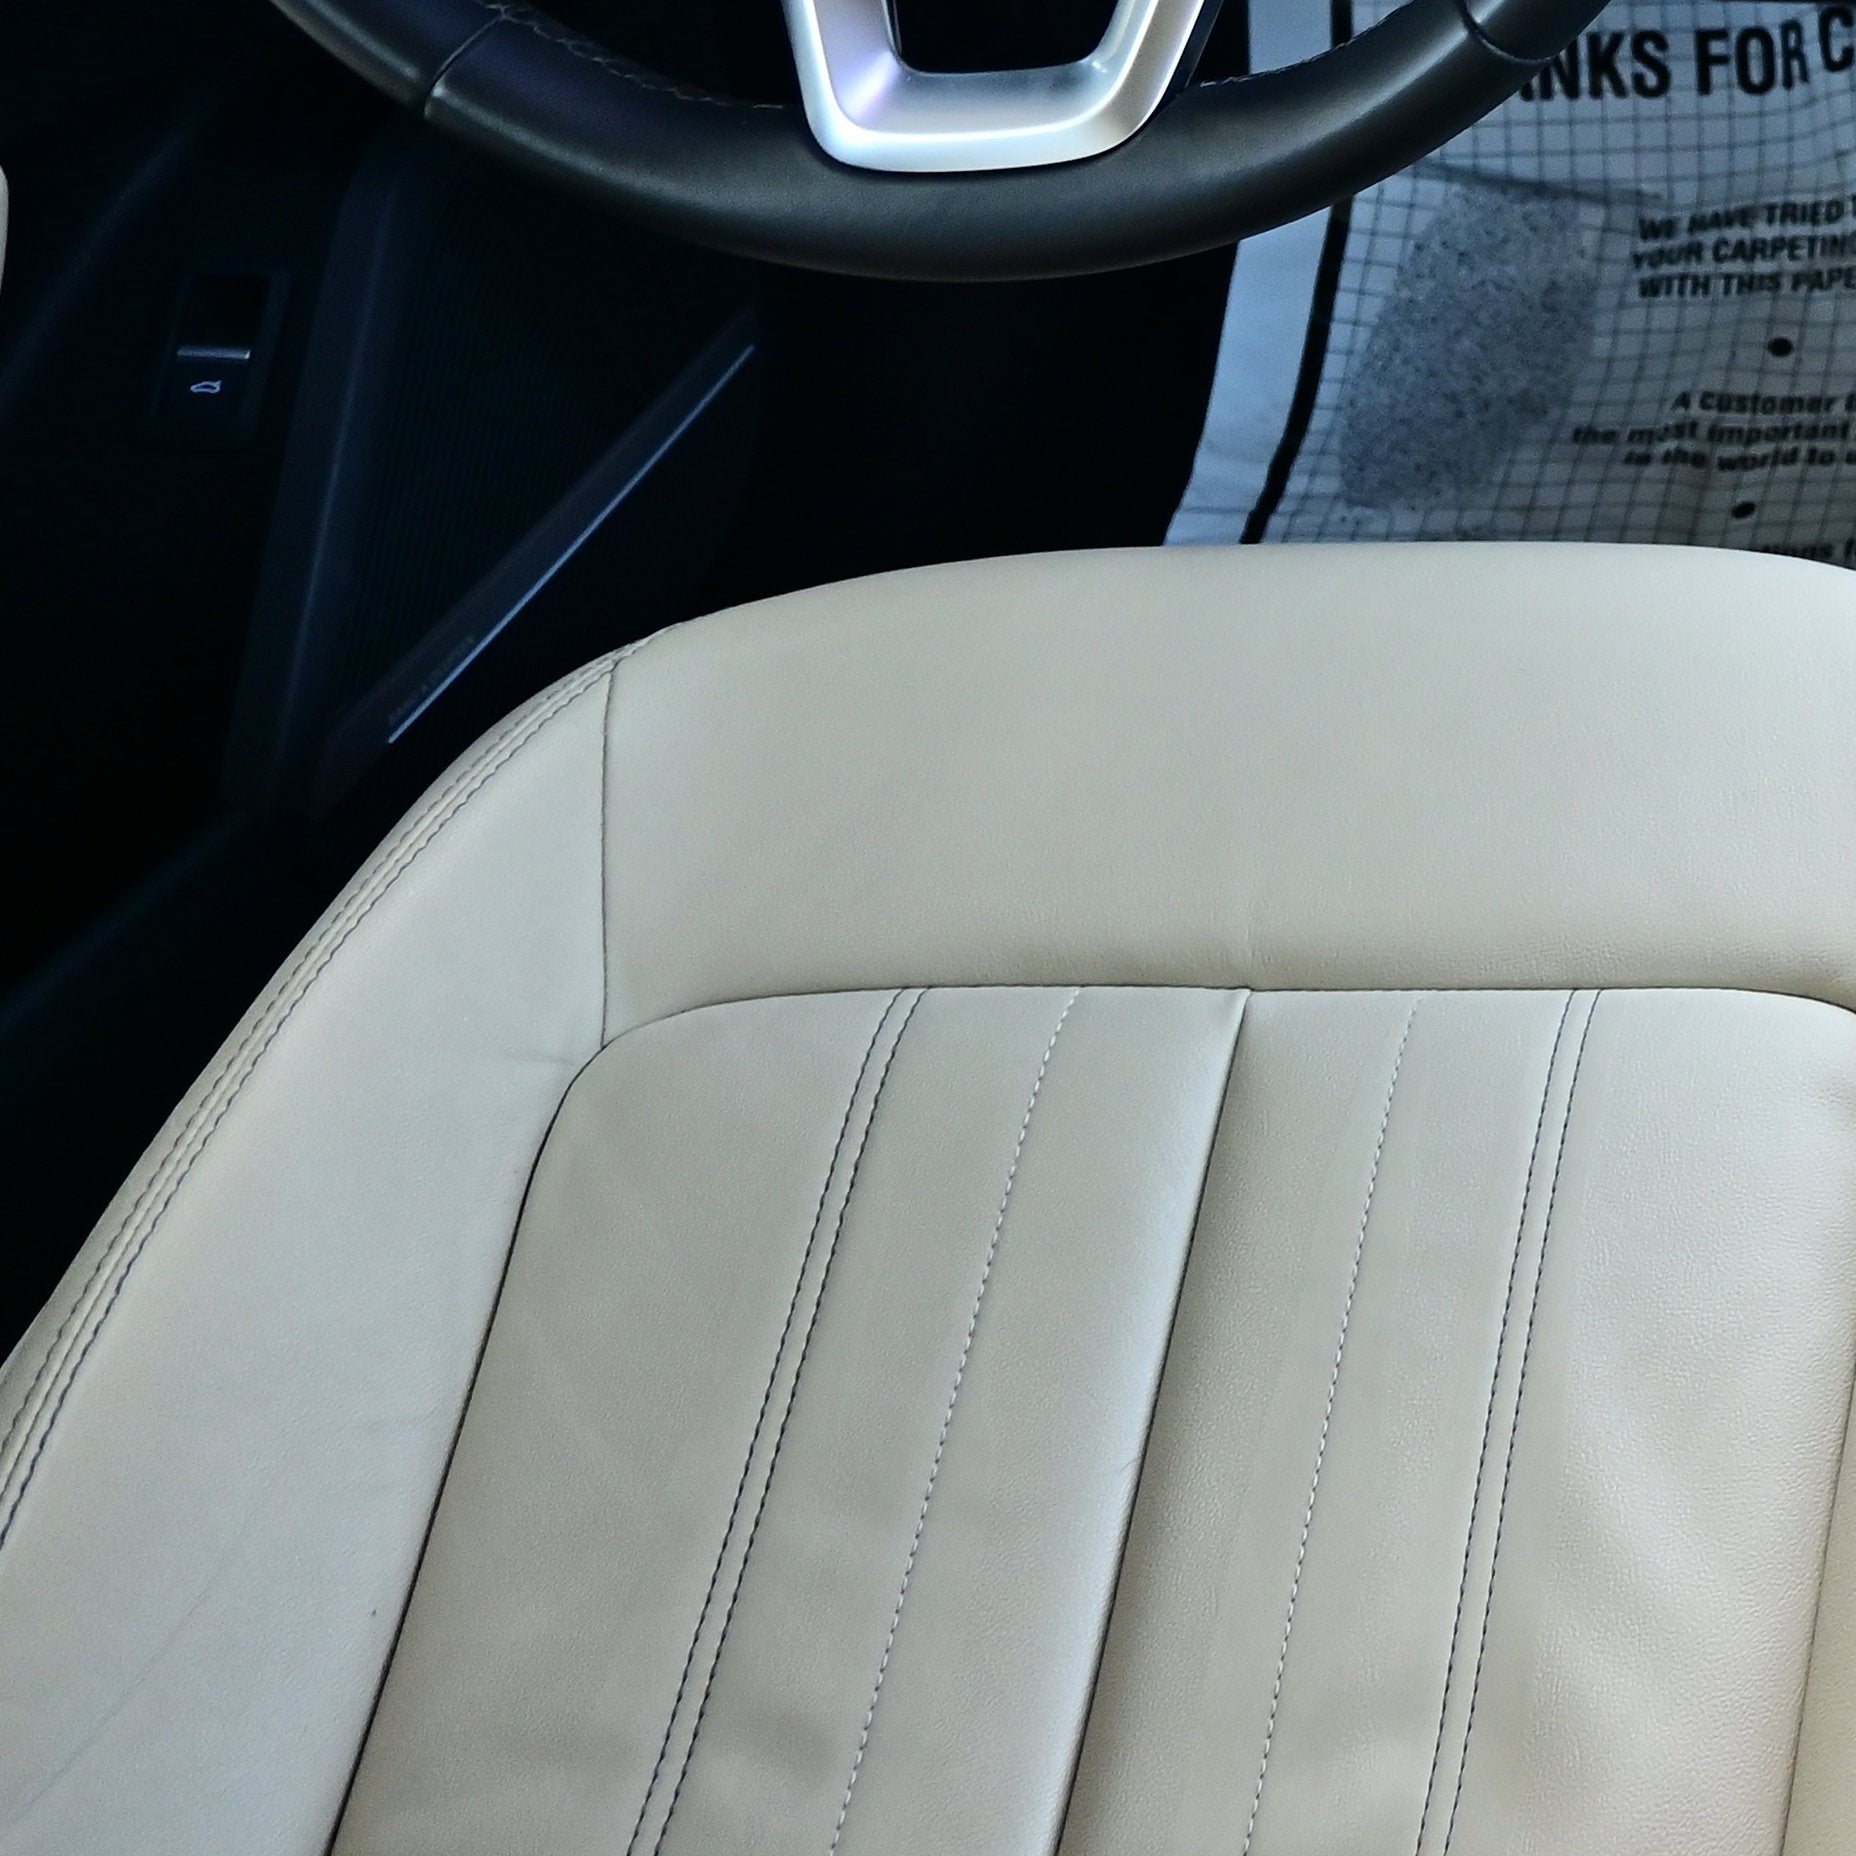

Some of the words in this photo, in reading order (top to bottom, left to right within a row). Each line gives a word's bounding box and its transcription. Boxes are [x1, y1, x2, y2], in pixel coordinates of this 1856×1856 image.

[1697, 22, 1811, 96] FOR
[1766, 199, 1844, 226] TRIED
[1639, 273, 1710, 298] WITH
[1722, 271, 1781, 296] THIS
[1672, 391, 1690, 411] A
[1699, 391, 1835, 415] customer
[1707, 420, 1850, 446] important
[1717, 447, 1798, 472] world
[1807, 447, 1835, 465] to
